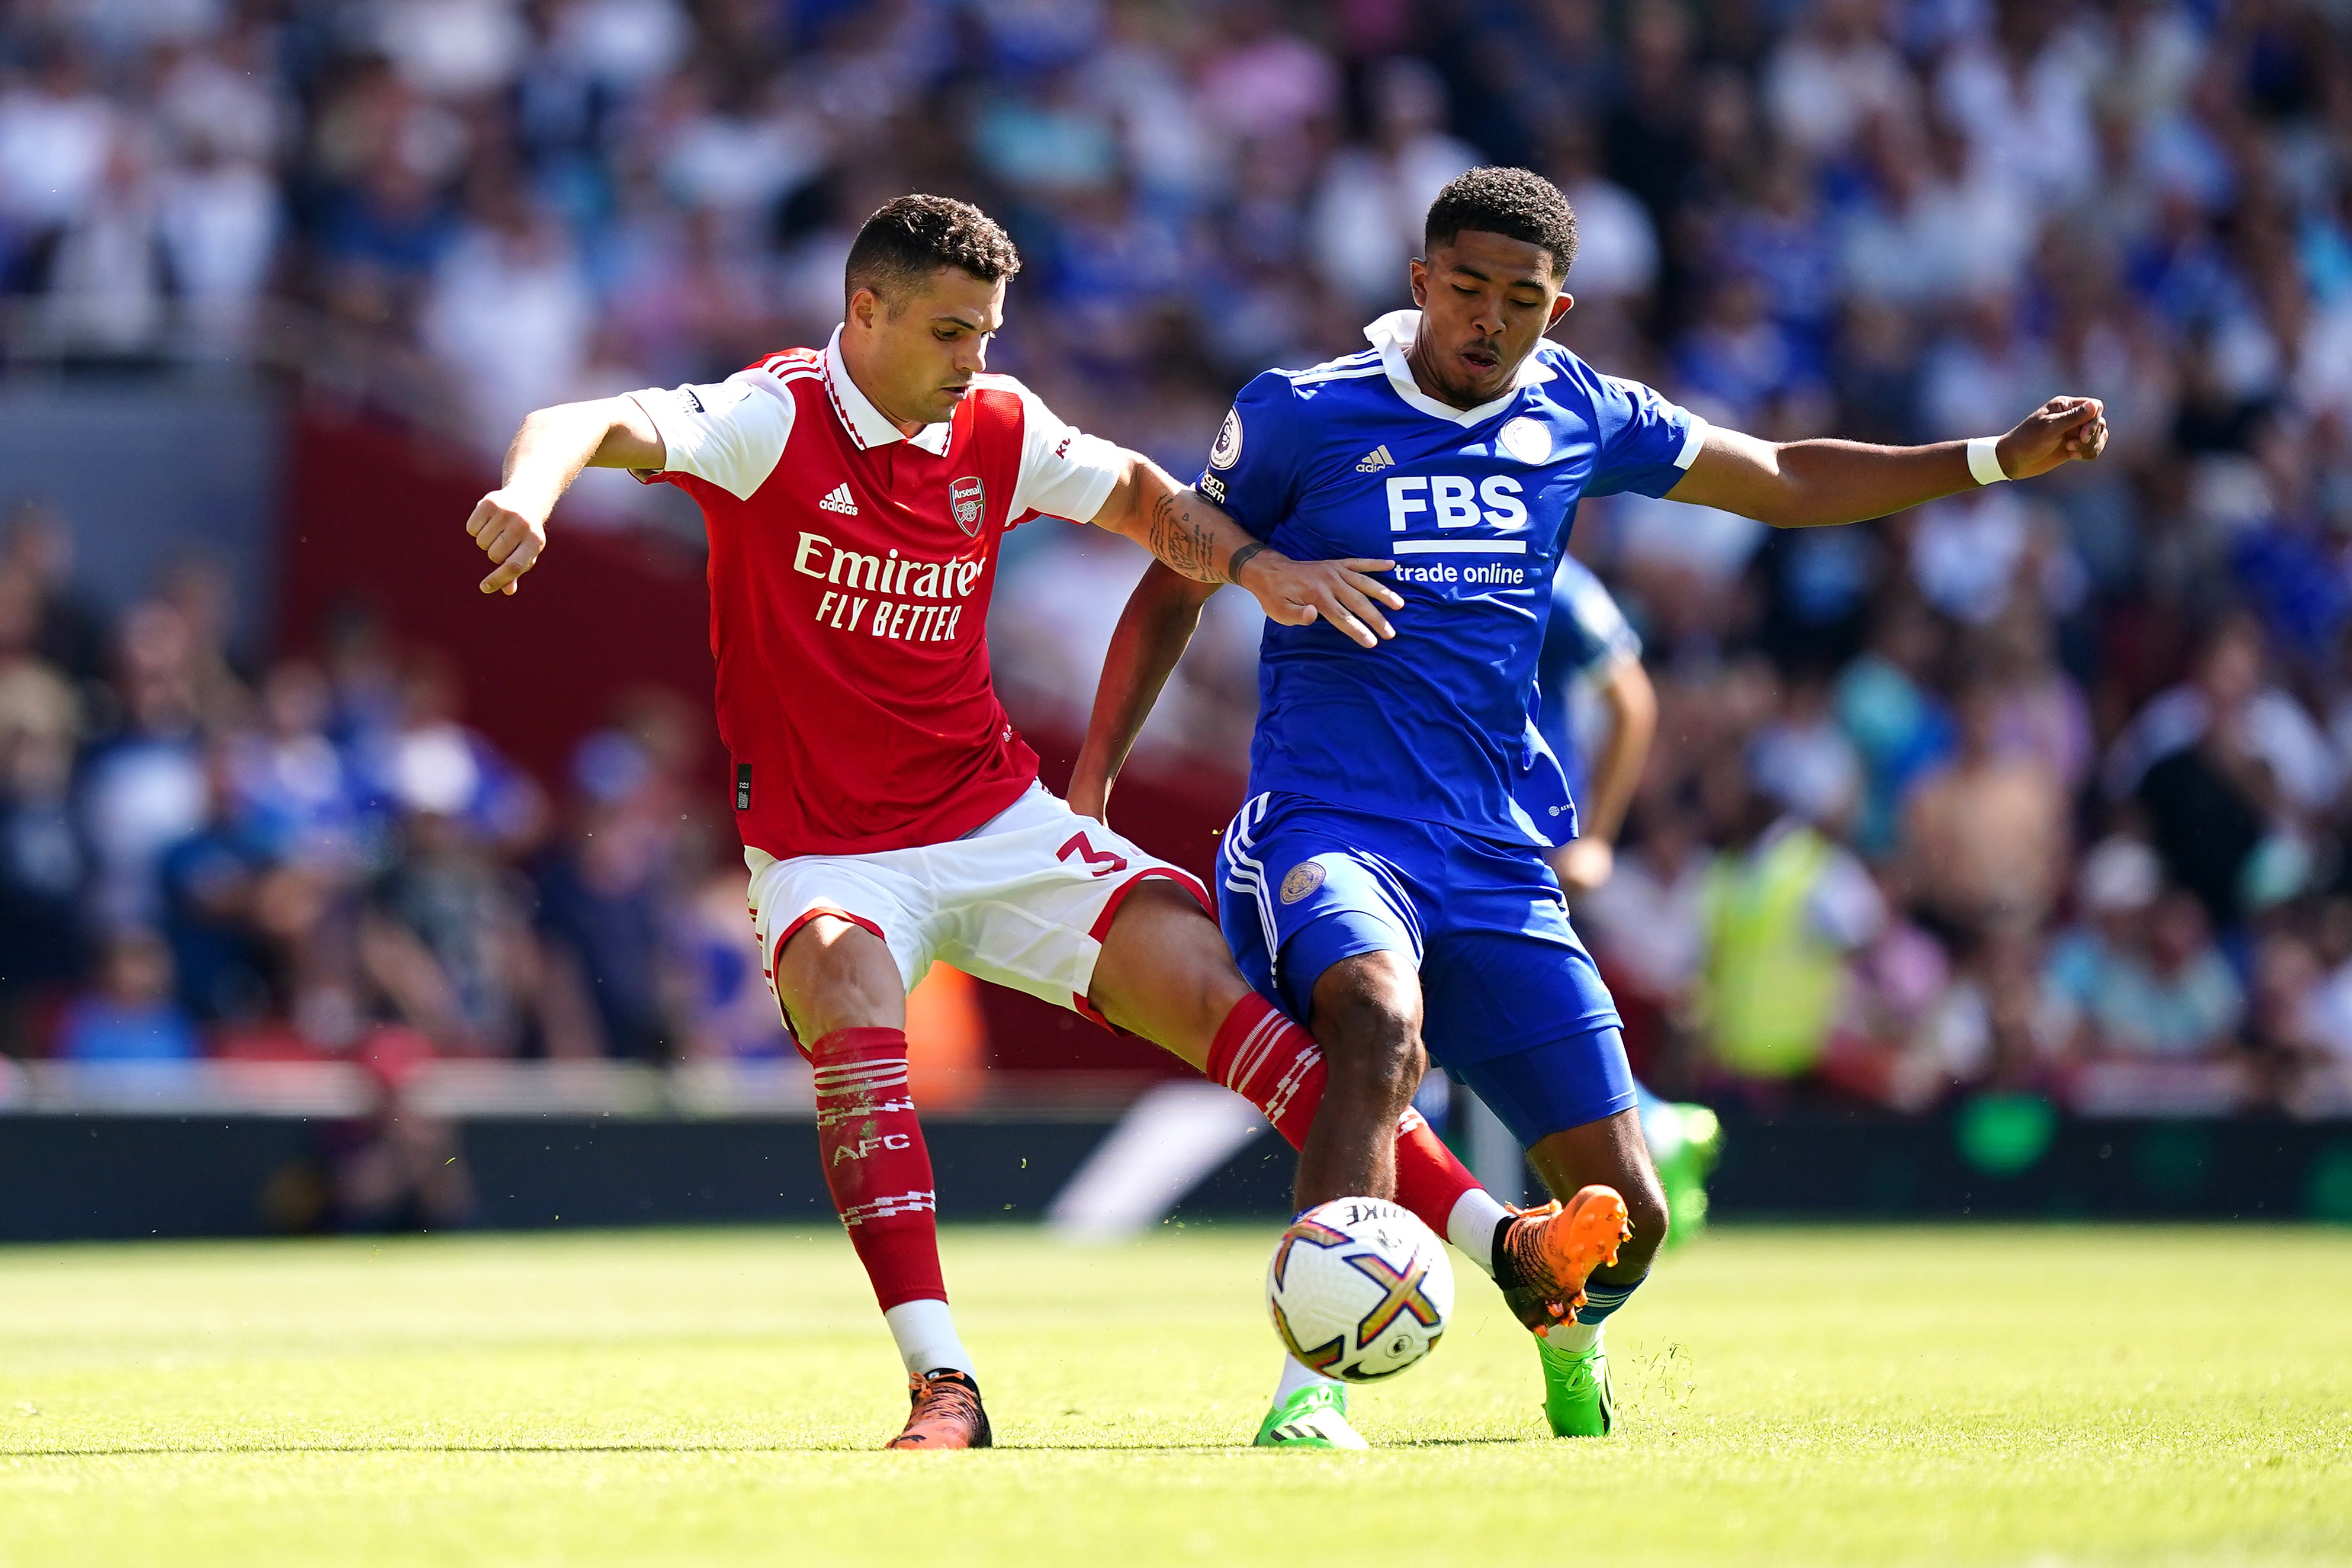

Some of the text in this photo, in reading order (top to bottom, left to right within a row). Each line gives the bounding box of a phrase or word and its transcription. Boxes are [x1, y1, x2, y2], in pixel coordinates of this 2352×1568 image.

[955, 484, 981, 499] Arsenal
[1386, 474, 1527, 531] FBS
[819, 500, 858, 516] adidas
[1394, 563, 1524, 584] trade online
[815, 591, 962, 641] FLY BETTER
[833, 1133, 910, 1166] AFC
